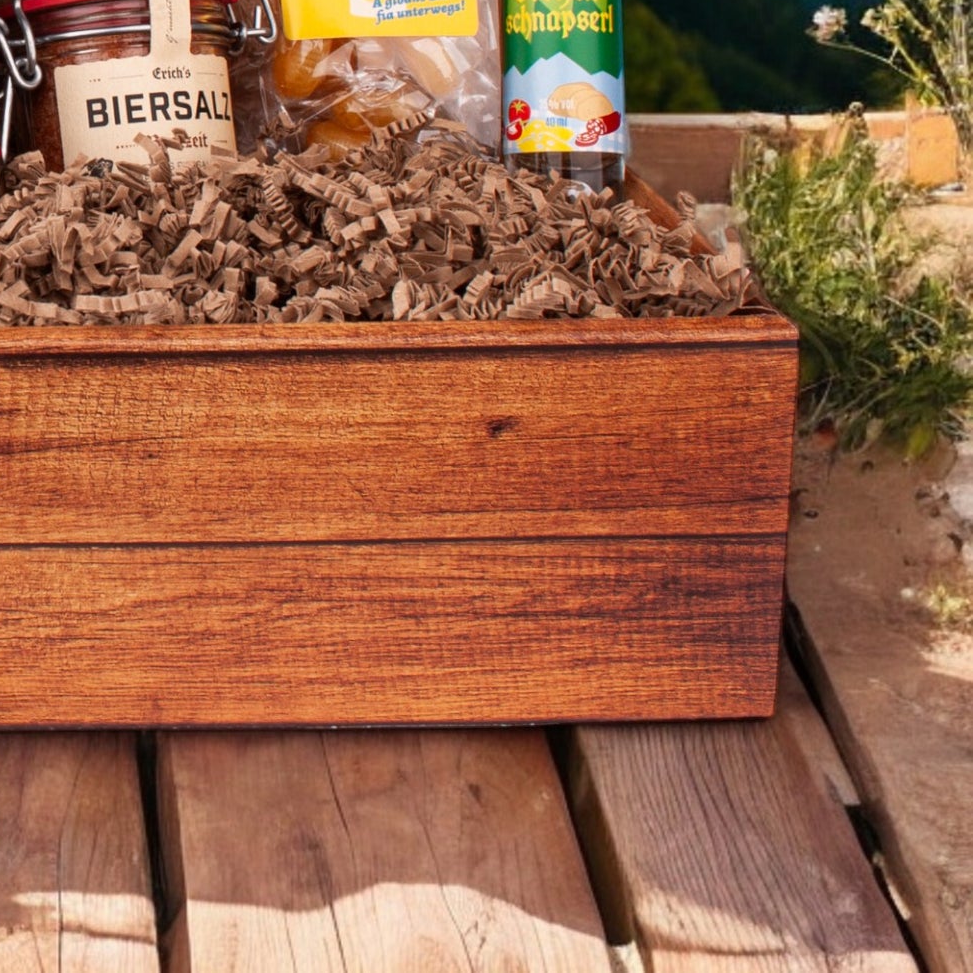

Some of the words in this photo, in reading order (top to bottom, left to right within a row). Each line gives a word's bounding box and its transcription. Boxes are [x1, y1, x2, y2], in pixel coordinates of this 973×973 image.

[375, 10, 395, 25] fia
[397, 0, 466, 19] unterwegs!
[505, 4, 614, 39] schnapserl
[152, 66, 191, 80] Erich's
[85, 90, 231, 129] BIERSALZ
